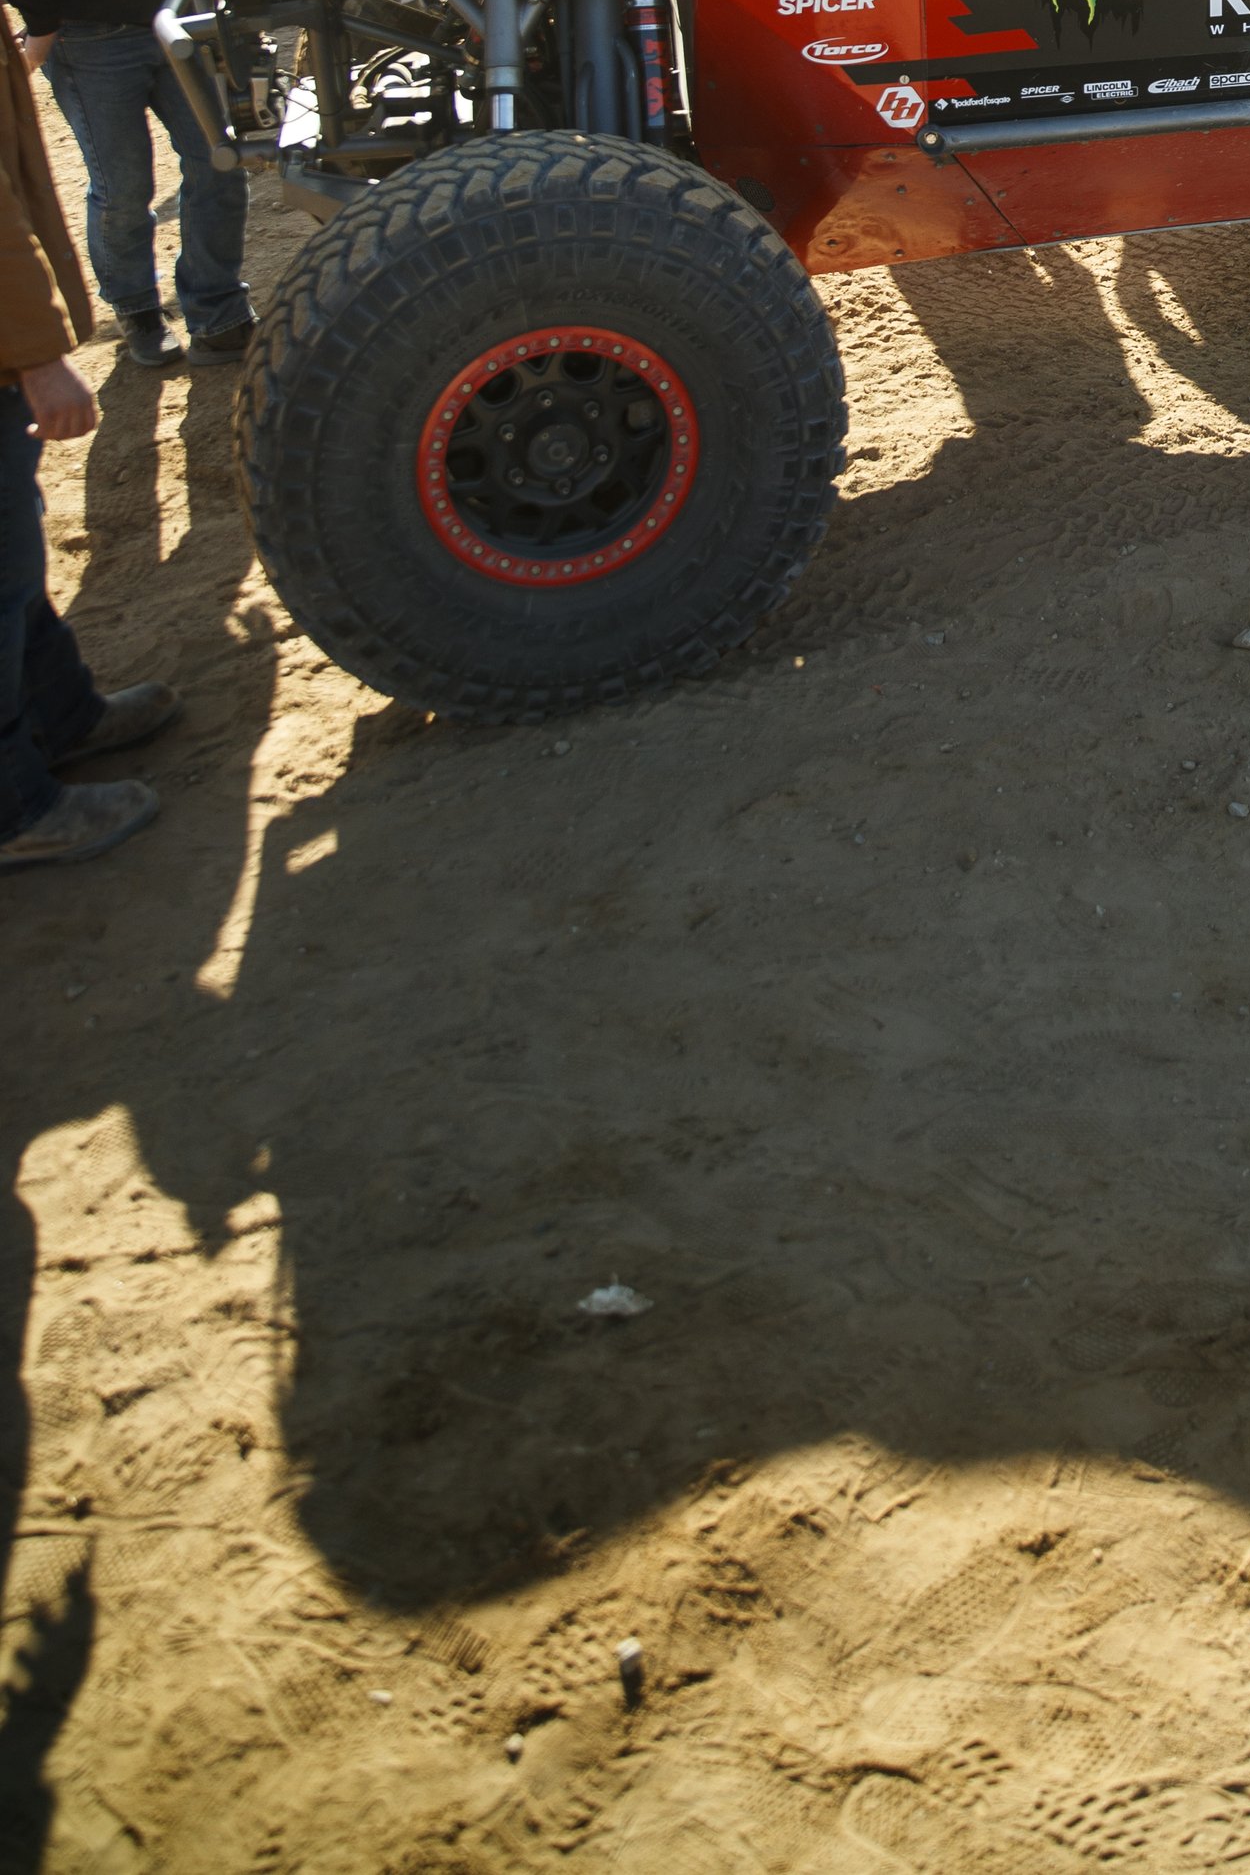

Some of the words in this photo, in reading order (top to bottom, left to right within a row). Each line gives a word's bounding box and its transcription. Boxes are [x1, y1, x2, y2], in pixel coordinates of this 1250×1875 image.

[1021, 85, 1060, 95] SPICER
[1086, 82, 1129, 93] LINCOLN
[1096, 89, 1134, 98] ELECTRIC
